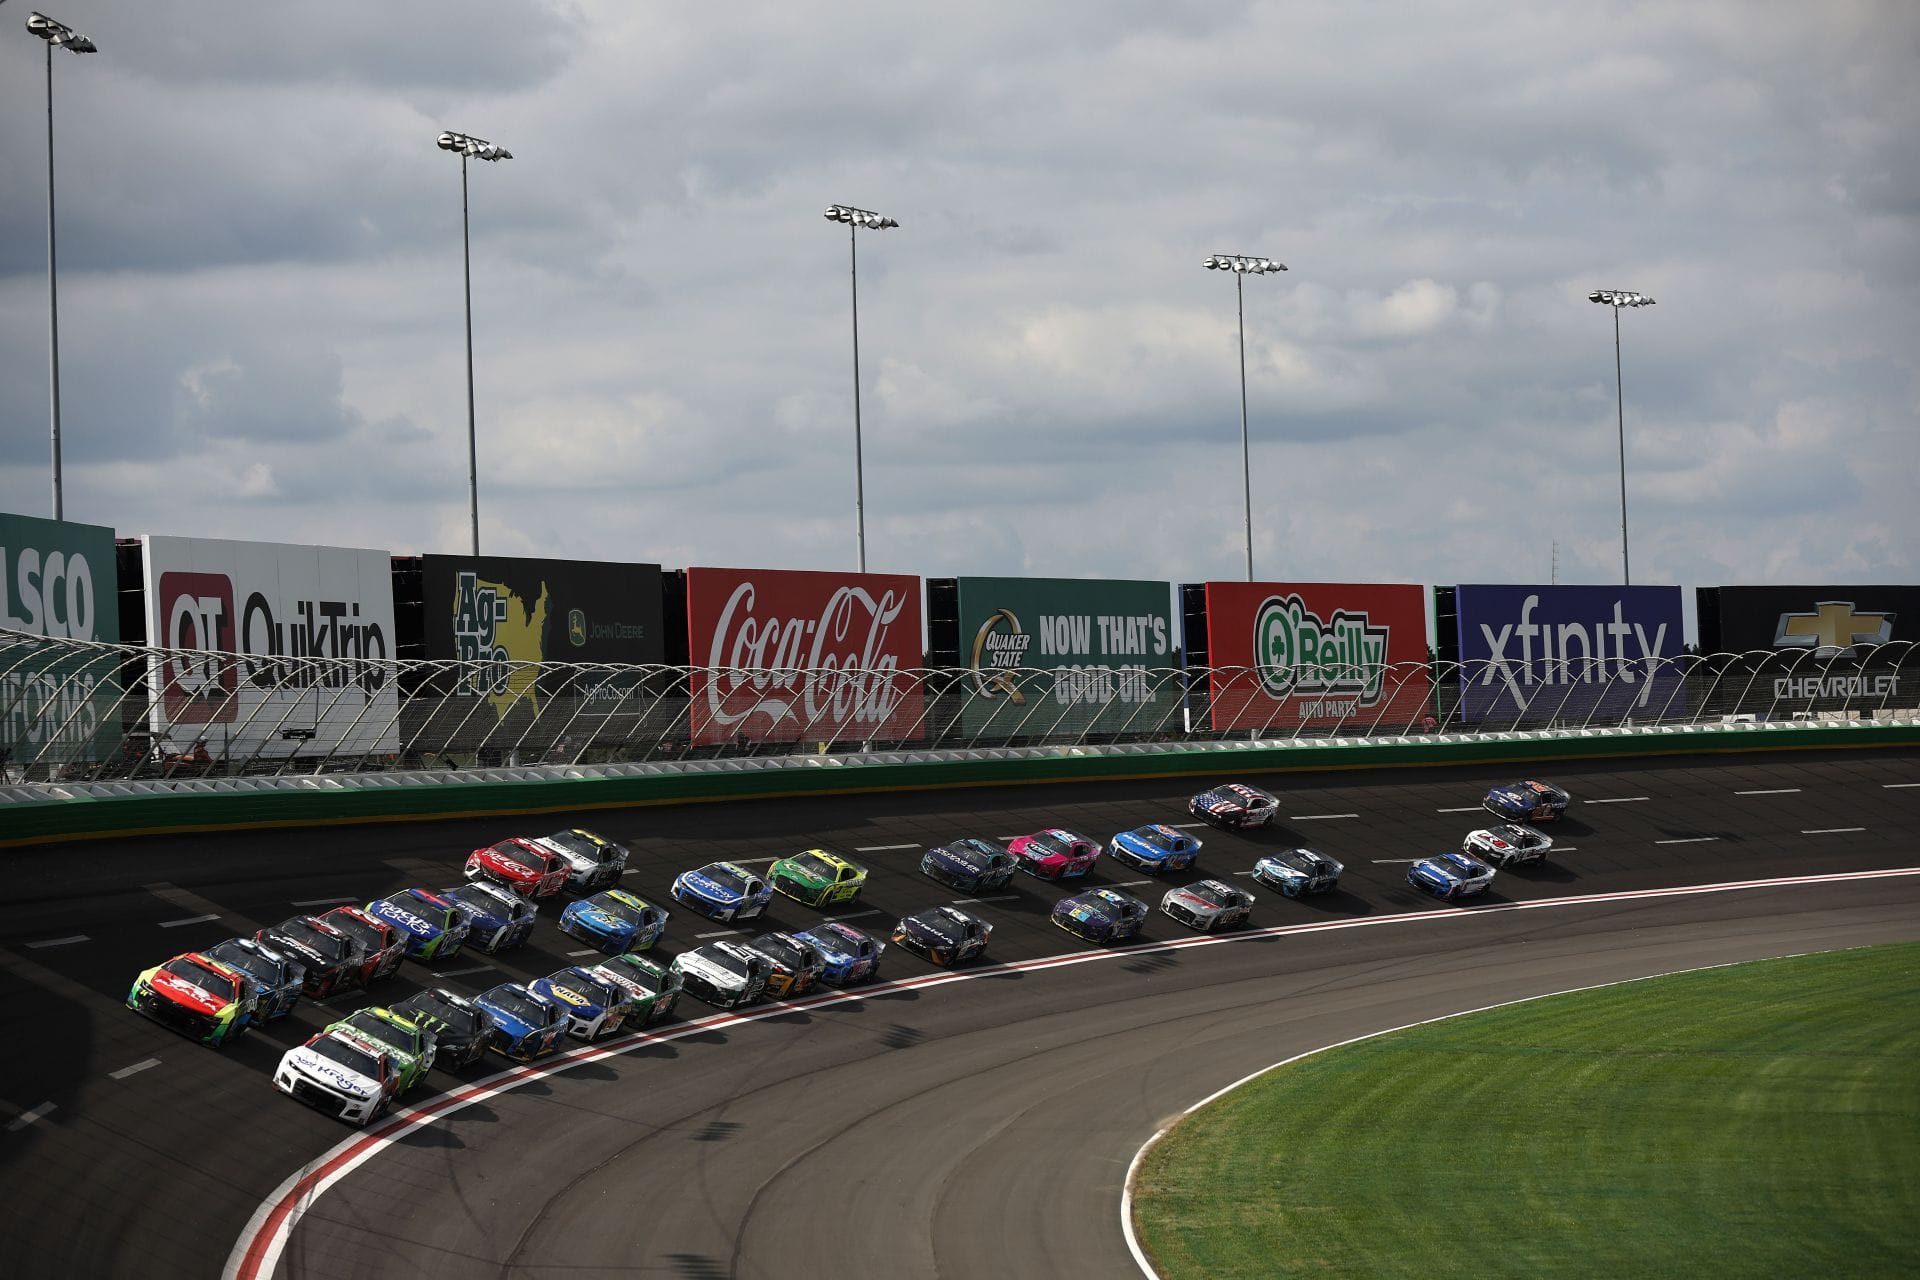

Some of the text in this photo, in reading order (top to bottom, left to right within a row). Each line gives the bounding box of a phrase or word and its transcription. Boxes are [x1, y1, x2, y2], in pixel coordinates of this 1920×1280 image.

[455, 571, 507, 647] Ag-
[169, 593, 225, 700] QT
[243, 592, 386, 708] QuikTrip
[590, 622, 644, 639] JOHN DEERE
[986, 631, 1031, 651] QUAKER
[1040, 613, 1167, 656] NOW THAT'S
[1260, 605, 1383, 694] O'Reilly
[456, 635, 509, 696] Pro
[708, 582, 907, 725] Coca-Cola
[990, 651, 1023, 667] STATE
[1479, 595, 1668, 711] xfinity
[584, 684, 634, 704] AgProCo.com
[1055, 664, 1112, 704] GOOD
[1774, 675, 1901, 699] CHEVROLET
[1298, 700, 1357, 718] AUTO PARTS
[556, 986, 586, 1005] NAPA
[317, 1063, 369, 1097] Kroger
